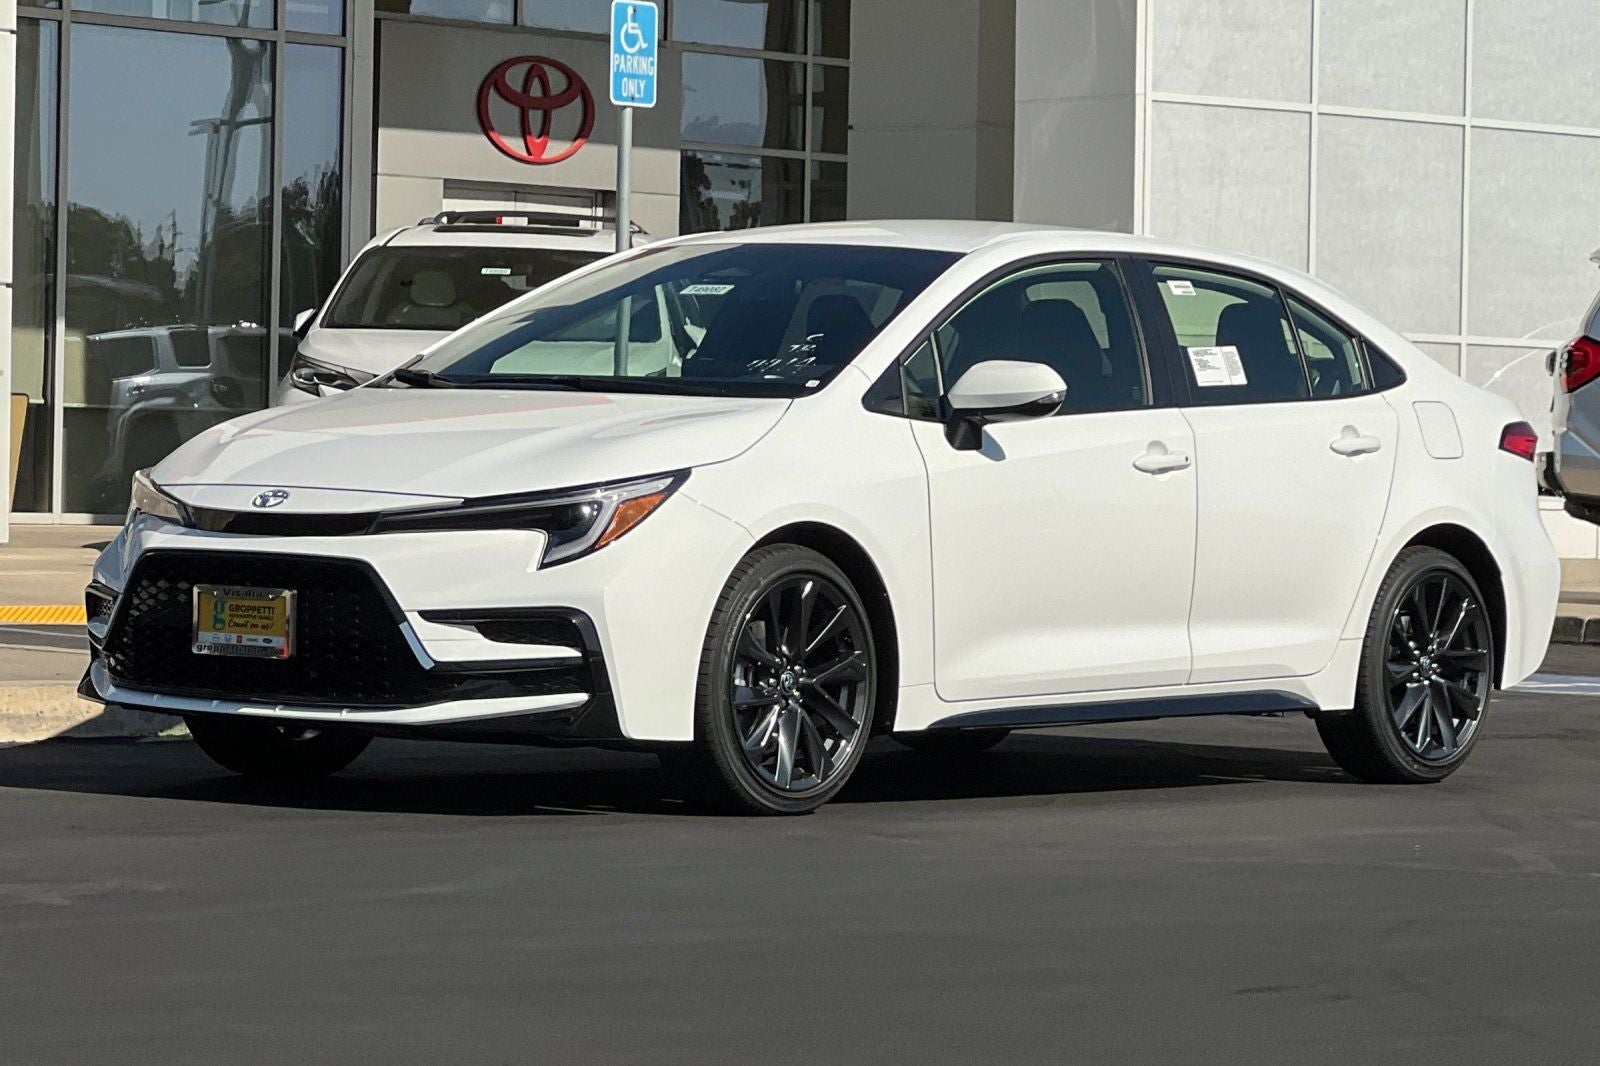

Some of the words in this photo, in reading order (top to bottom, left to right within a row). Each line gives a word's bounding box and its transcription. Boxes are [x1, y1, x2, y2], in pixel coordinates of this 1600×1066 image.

[614, 53, 654, 76] PARKING
[621, 77, 646, 99] ONLY
[228, 604, 275, 615] GROPPETTI
